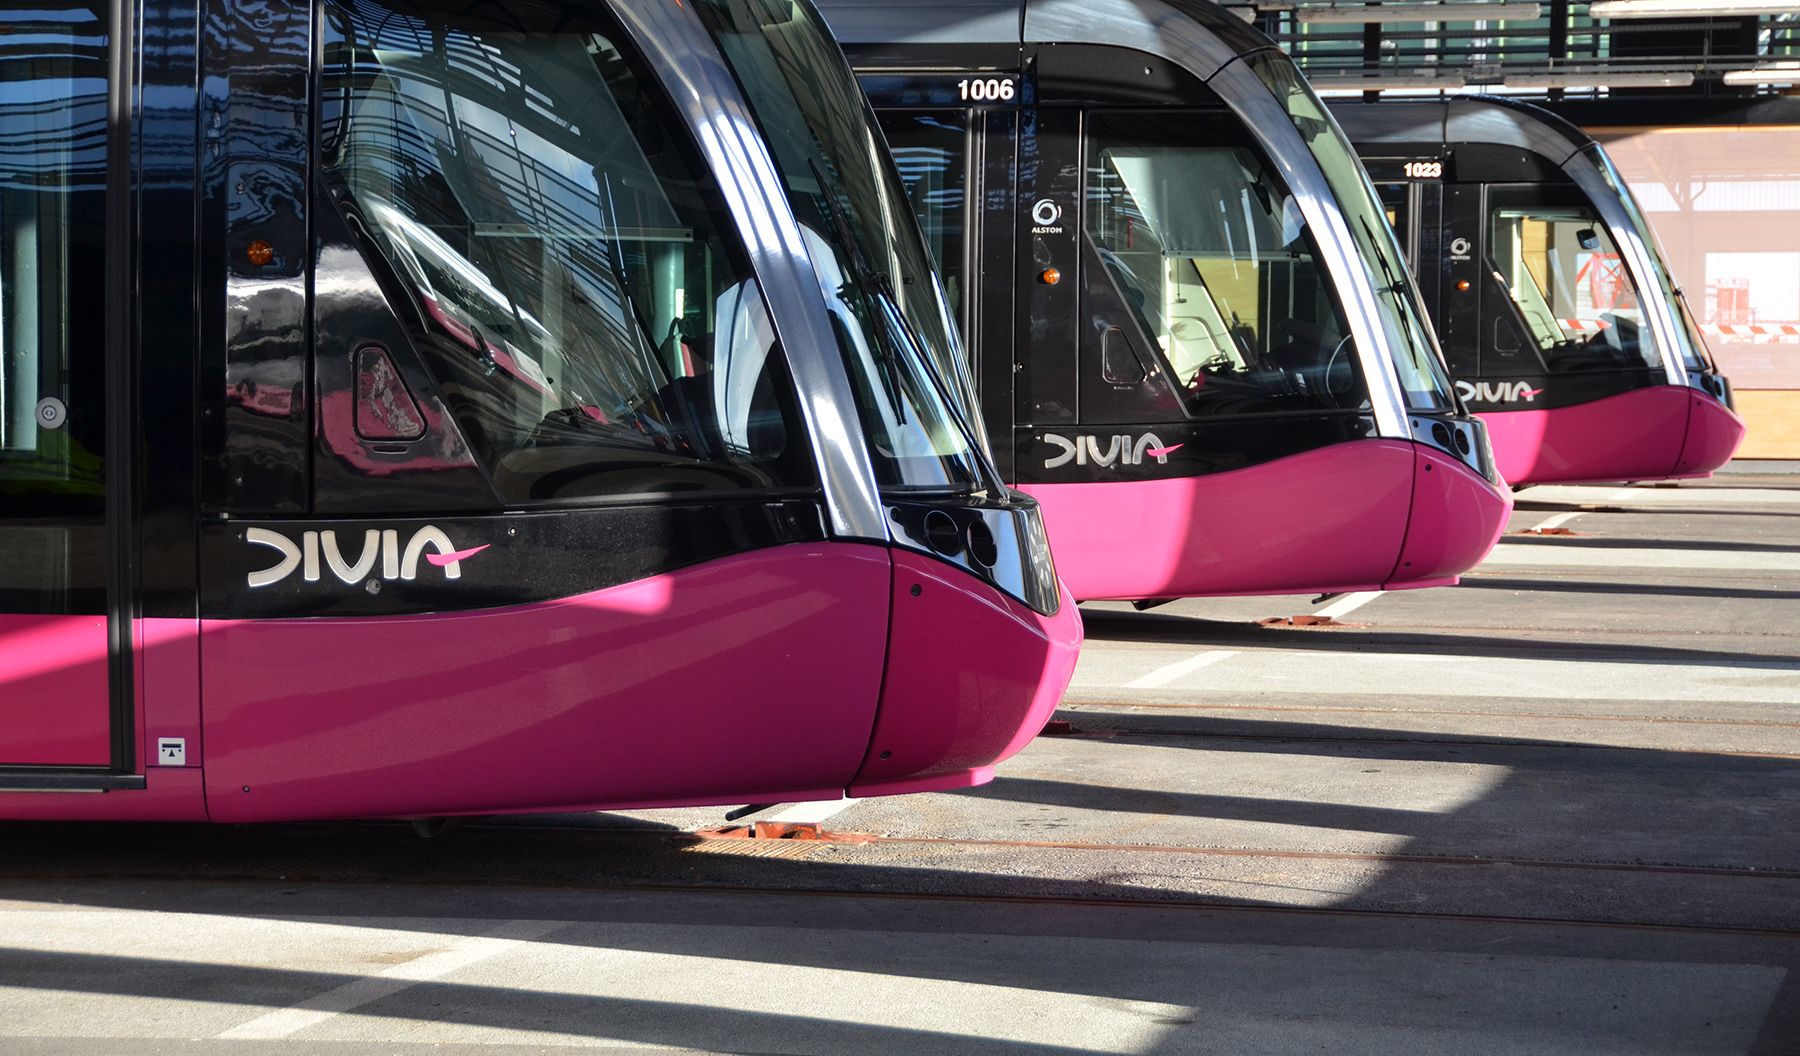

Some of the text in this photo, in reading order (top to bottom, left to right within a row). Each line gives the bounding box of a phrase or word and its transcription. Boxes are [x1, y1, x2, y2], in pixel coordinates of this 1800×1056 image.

[958, 79, 1015, 101] 1006
[1404, 162, 1442, 178] 1023
[1455, 380, 1545, 404] DIVIA
[1043, 431, 1185, 470] DIVIA
[246, 524, 492, 588] DIVIA
